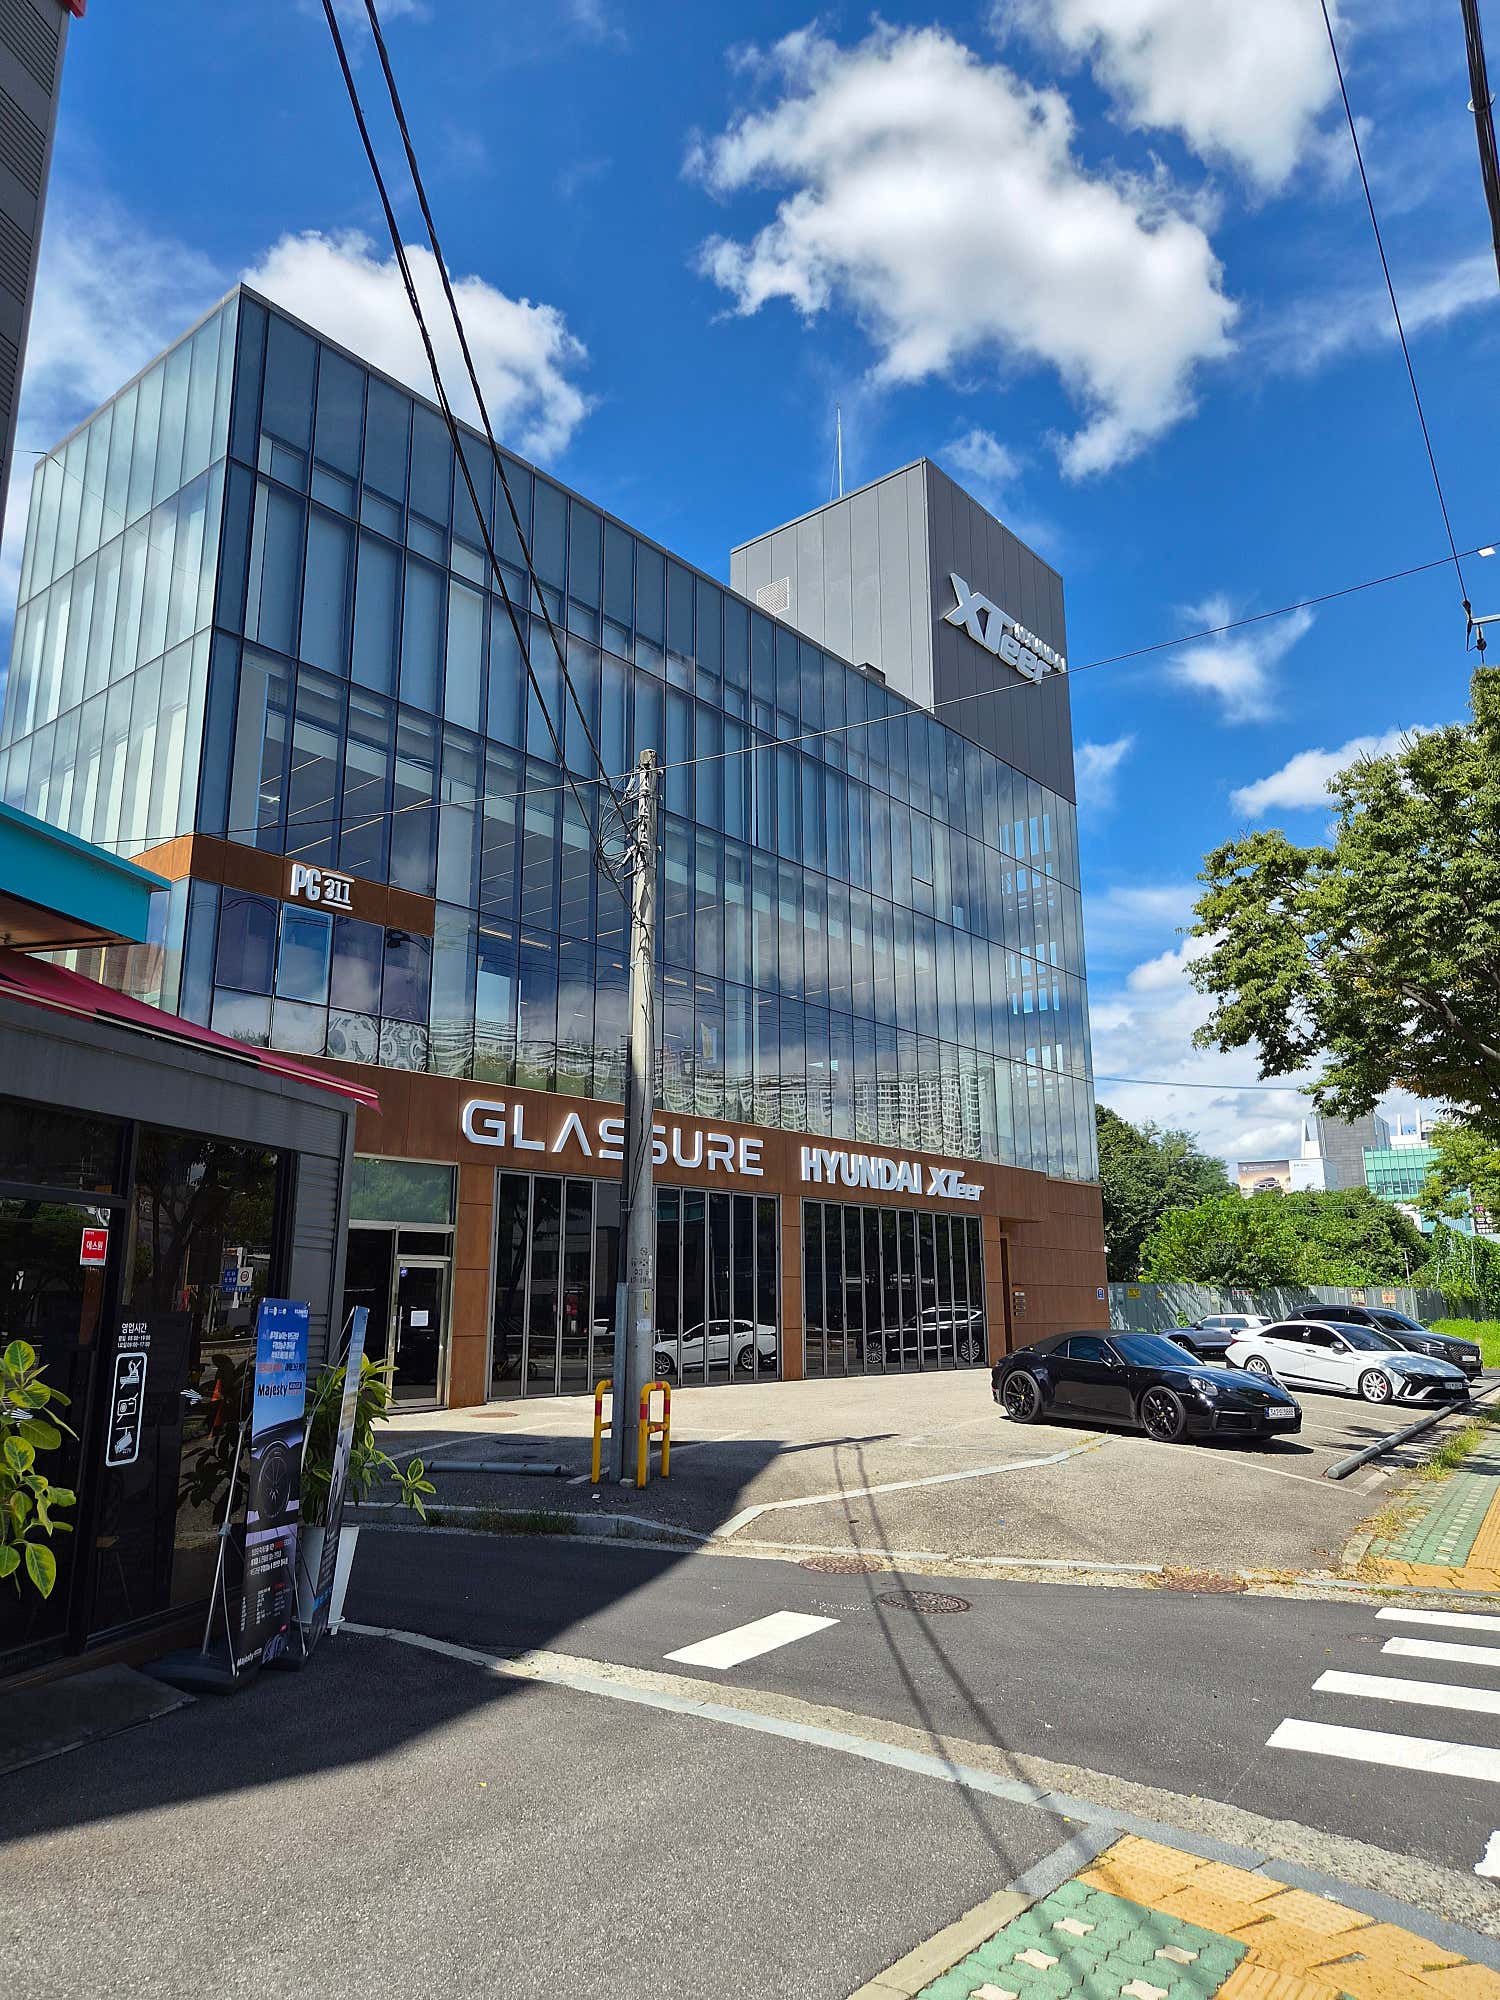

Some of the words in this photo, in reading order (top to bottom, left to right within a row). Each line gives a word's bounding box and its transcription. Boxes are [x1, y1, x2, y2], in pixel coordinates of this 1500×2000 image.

[944, 573, 1052, 685] XTeer
[323, 879, 351, 904] 311
[800, 1146, 922, 1195] HYUNDAI
[926, 1166, 984, 1201] XTeer
[121, 1322, 147, 1334] 영업시간
[257, 1382, 288, 1398] Majesty
